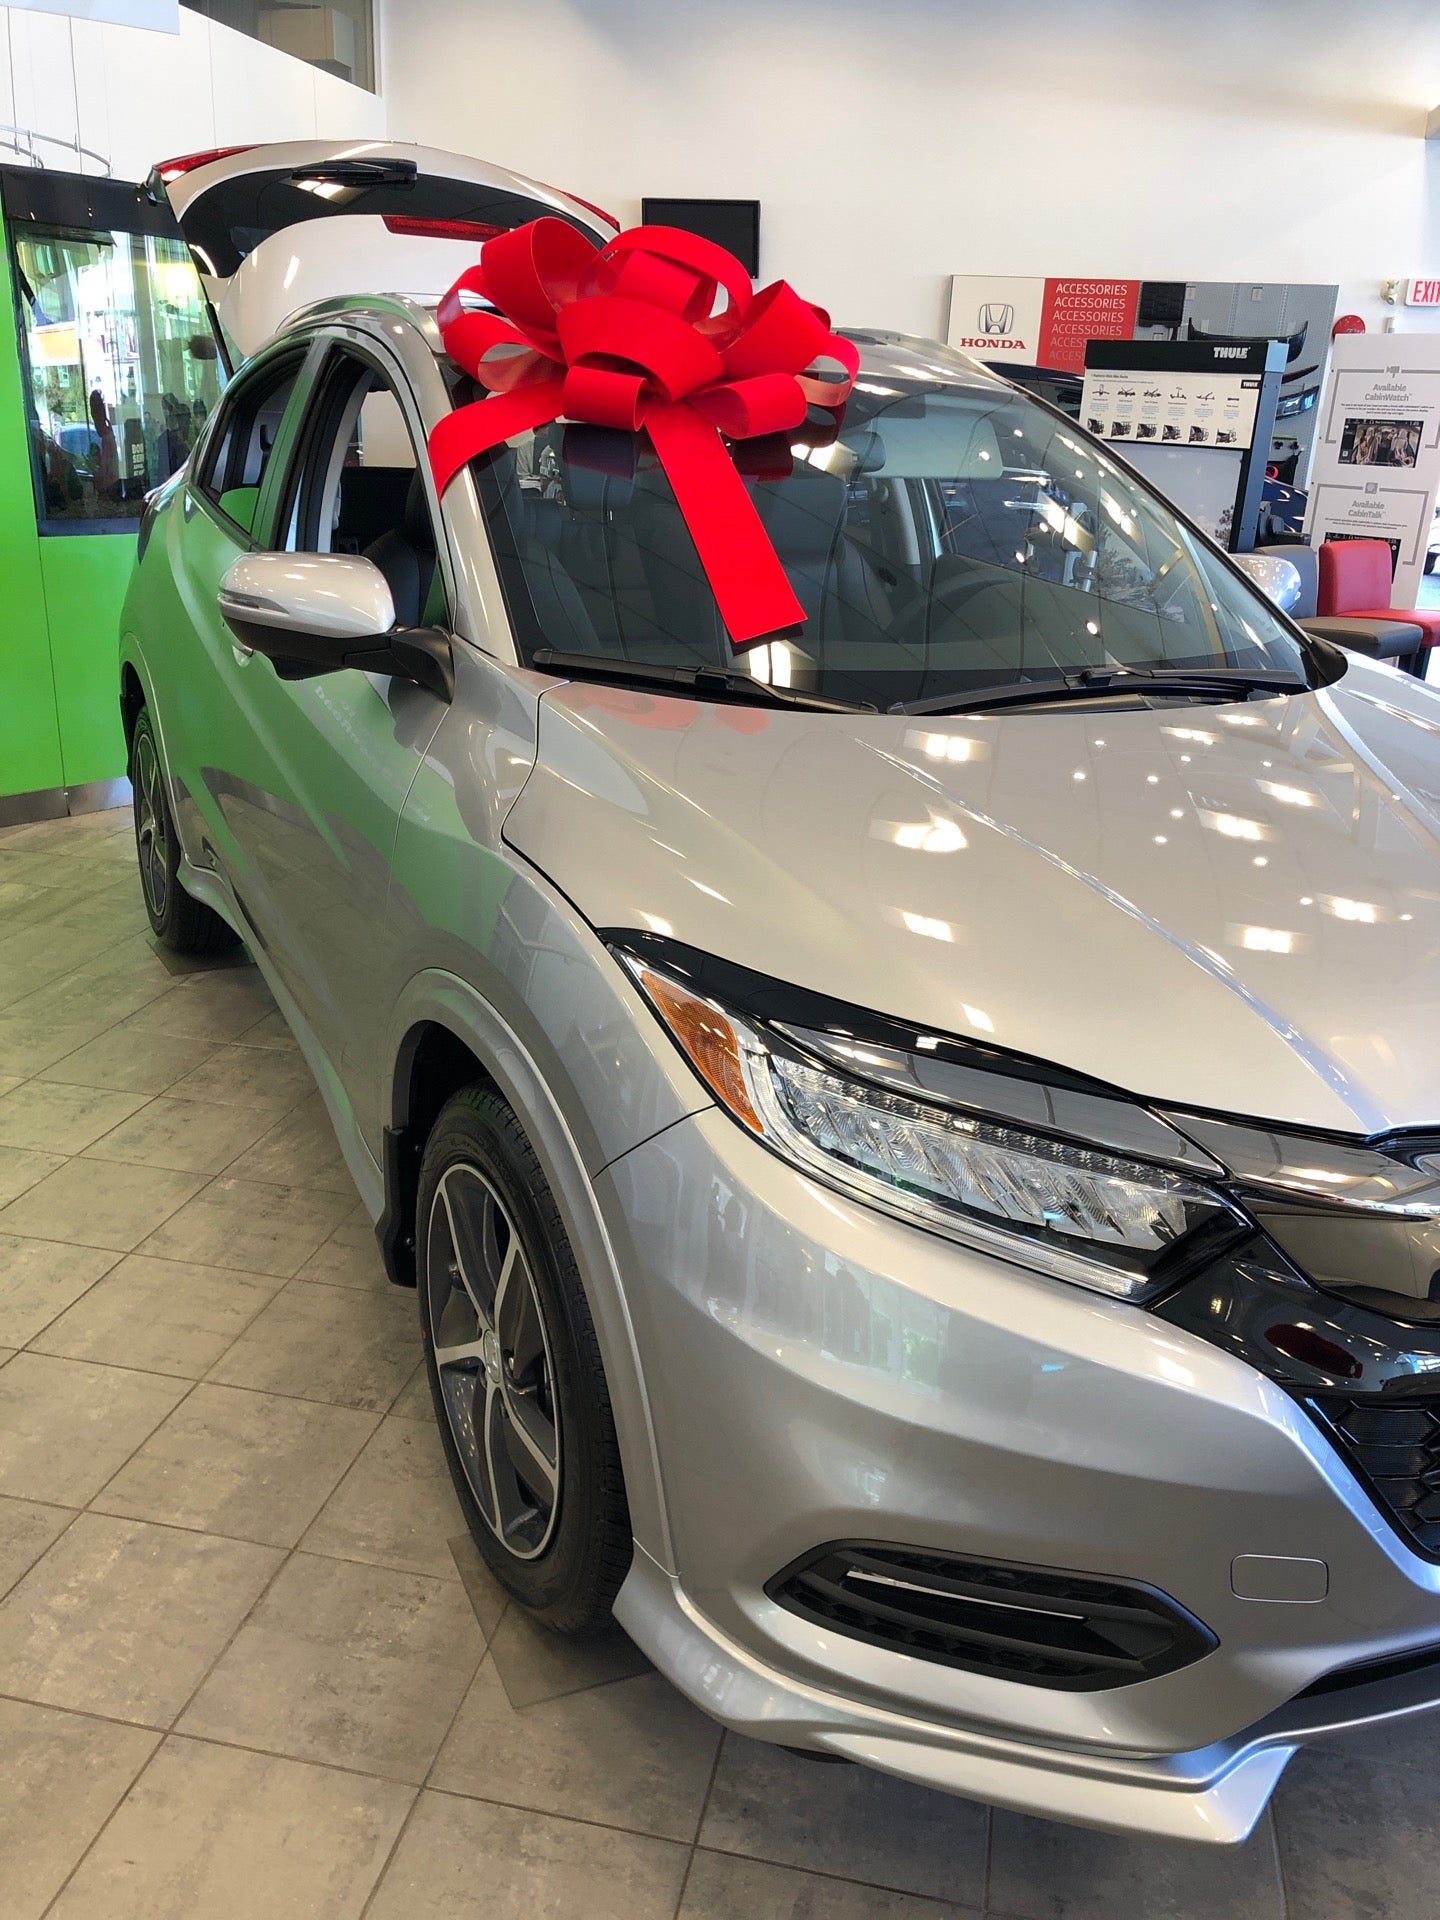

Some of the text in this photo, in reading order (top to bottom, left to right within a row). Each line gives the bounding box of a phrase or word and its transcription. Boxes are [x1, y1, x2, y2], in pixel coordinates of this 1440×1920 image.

[1055, 283, 1128, 296] ACCESSORIES
[1054, 297, 1126, 309] ACCESSORIES
[1052, 310, 1124, 323] ACCESSORIES
[1051, 323, 1122, 336] ACCESSORIES
[960, 337, 1026, 349] HONDA
[1213, 346, 1249, 359] THULE
[1373, 383, 1407, 392] Available
[1352, 500, 1385, 509] Available
